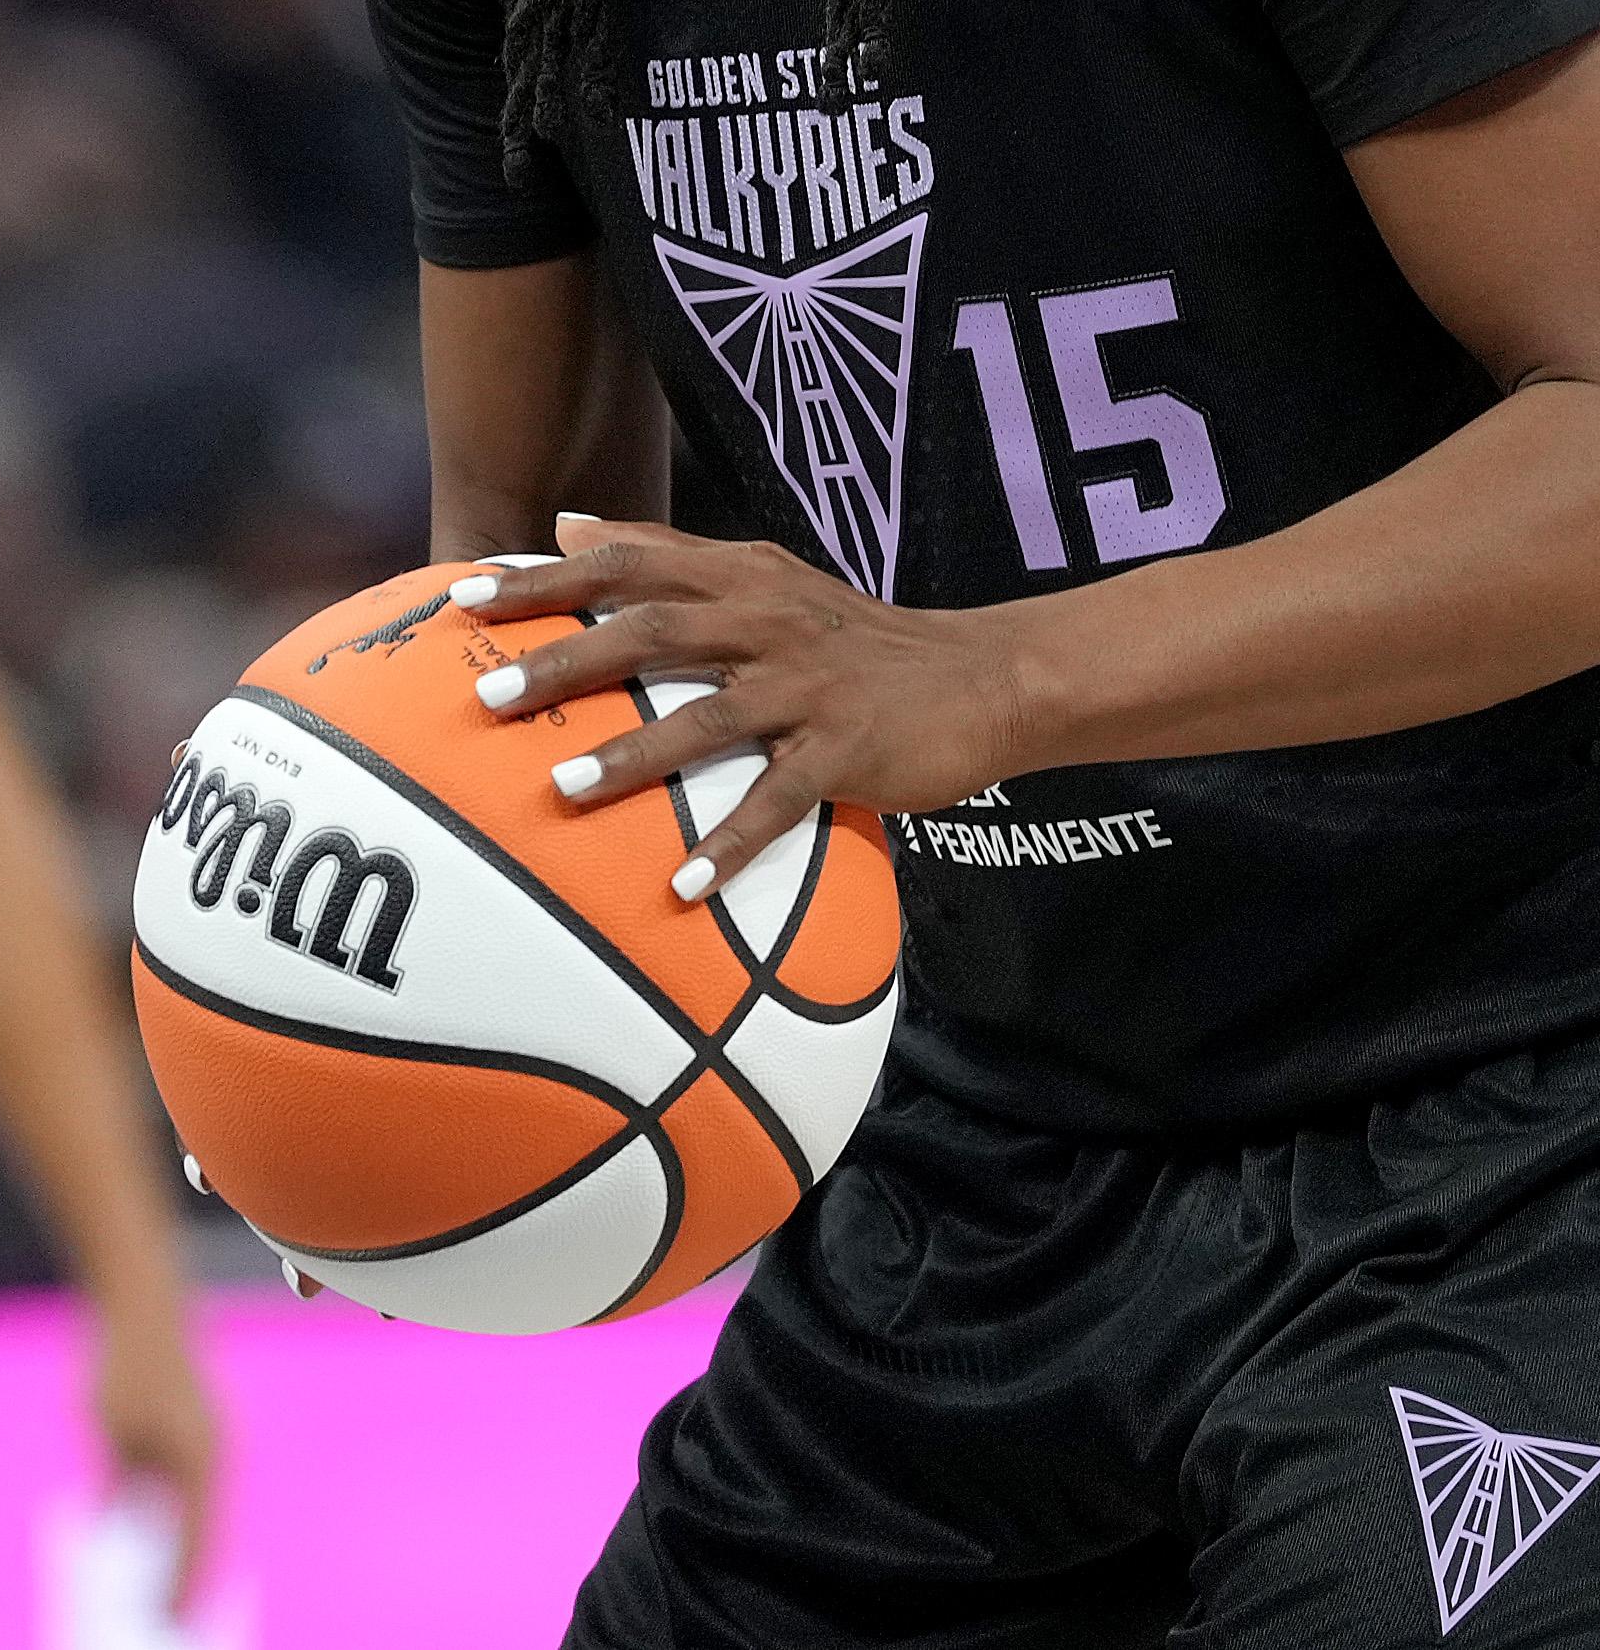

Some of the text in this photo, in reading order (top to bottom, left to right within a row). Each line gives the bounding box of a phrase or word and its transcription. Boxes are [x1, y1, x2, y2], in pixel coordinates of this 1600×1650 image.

[647, 52, 767, 109] GOLDEN
[625, 95, 935, 265] VALKYRIES
[952, 273, 1230, 572] 15
[264, 751, 302, 778] EVO
[162, 752, 420, 997] Wilso
[923, 808, 1173, 867] PERMANENTE
